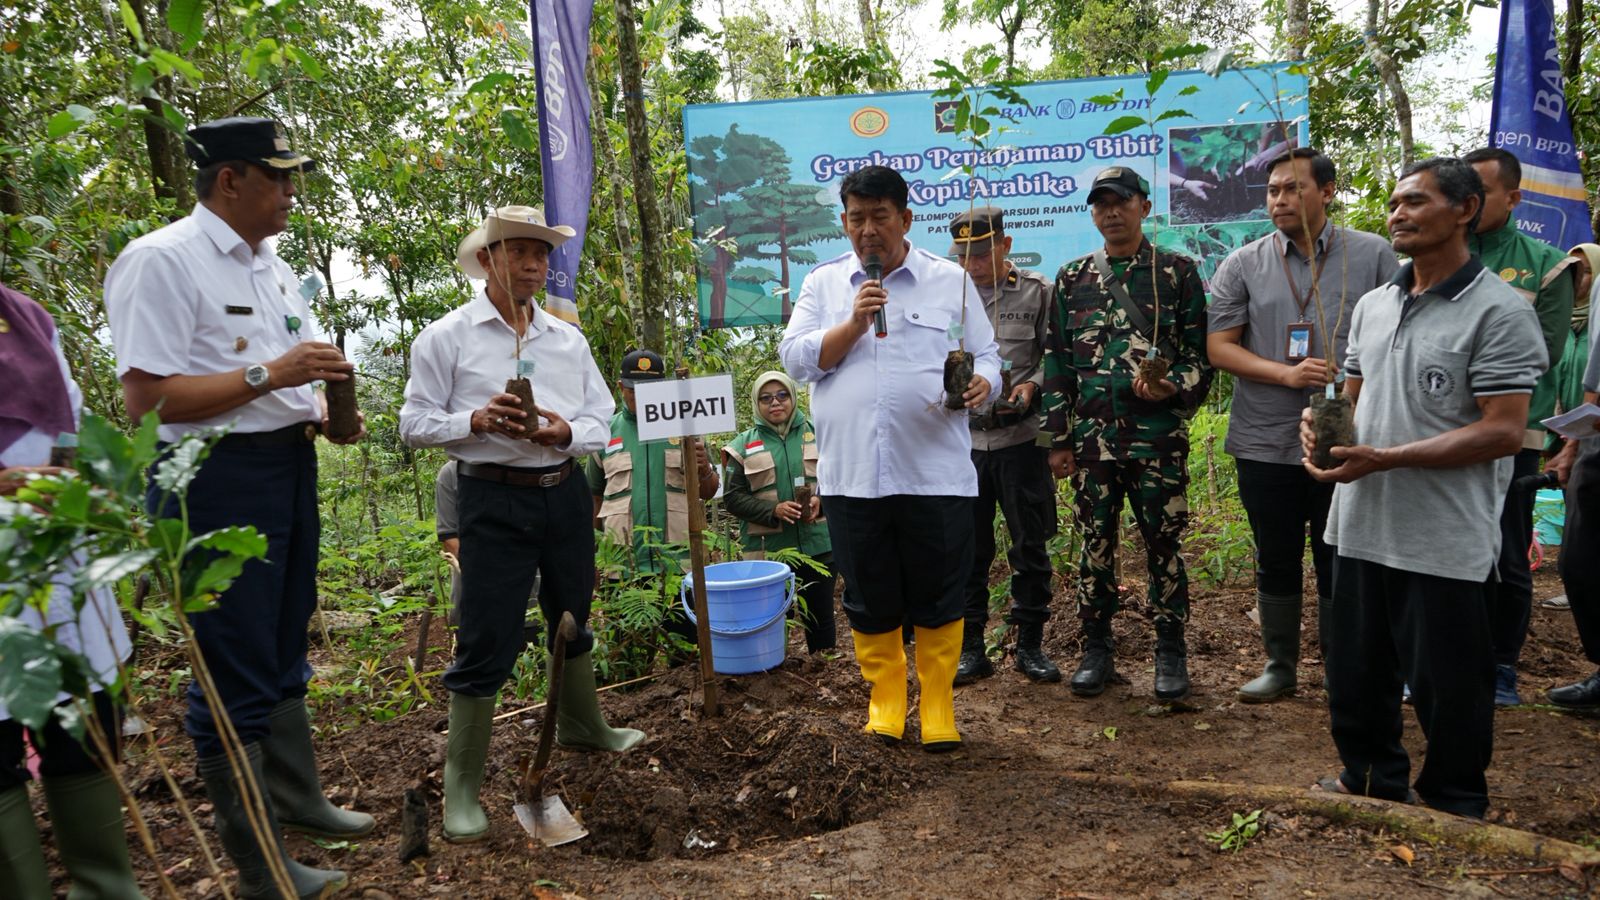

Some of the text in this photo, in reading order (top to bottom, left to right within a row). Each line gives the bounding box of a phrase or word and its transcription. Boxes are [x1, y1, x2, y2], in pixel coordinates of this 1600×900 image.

[999, 105, 1052, 119] BANK
[1122, 98, 1156, 110] DIY
[926, 145, 1084, 168] Penanaman
[1087, 135, 1164, 158] Bibit
[1535, 138, 1571, 154] BPD
[907, 171, 1077, 206] Kopi Arabika
[1043, 204, 1088, 215] RAHAYU
[1515, 218, 1545, 234] ANK
[1000, 312, 1034, 321] POLRI
[644, 396, 727, 423] BUPATI
